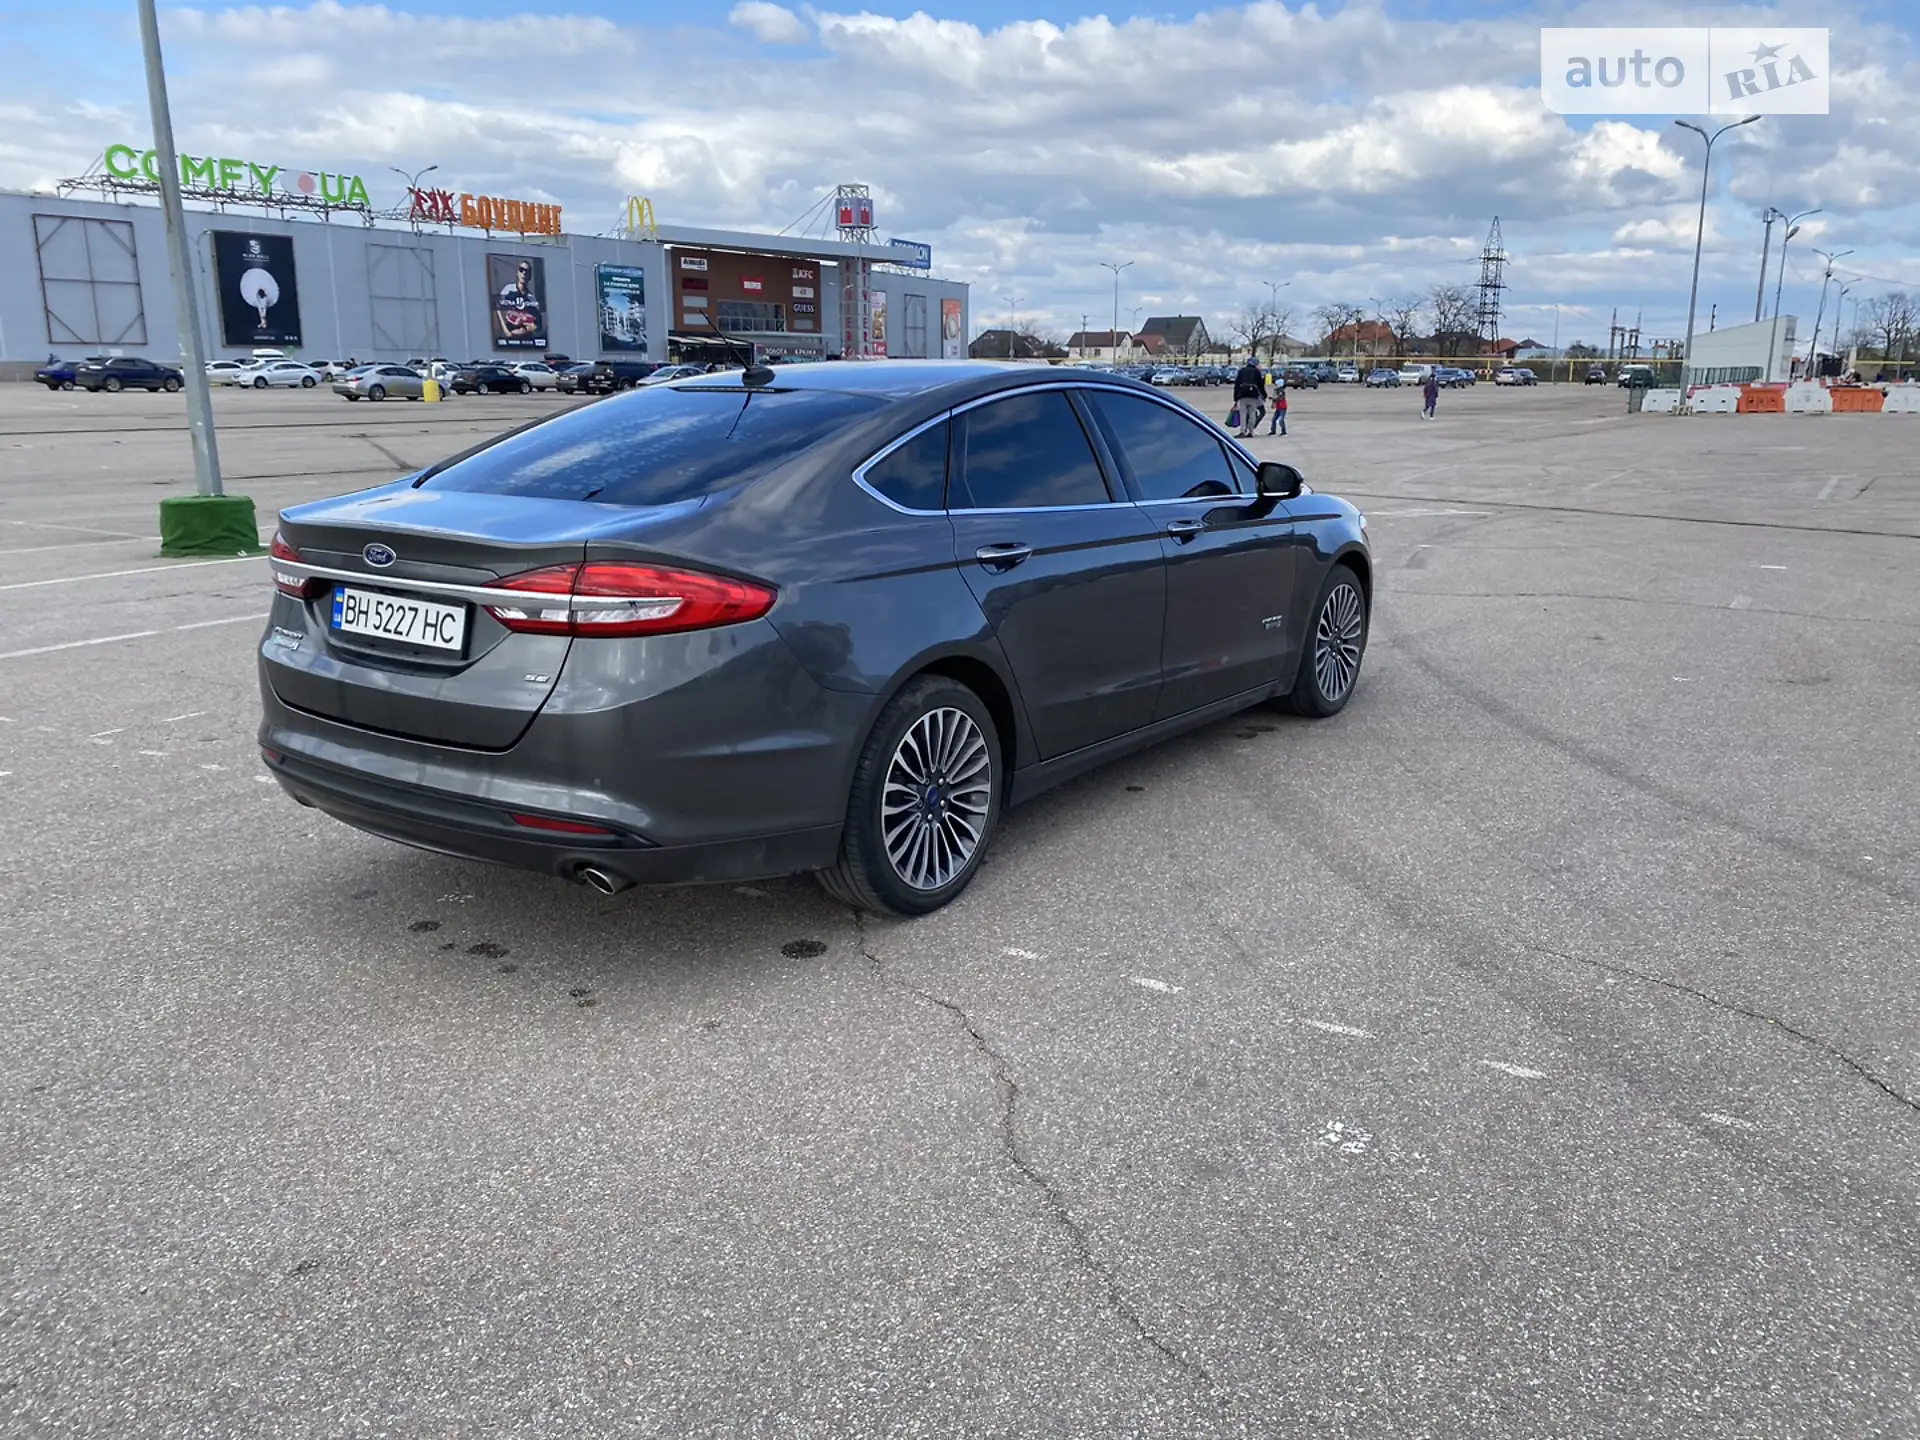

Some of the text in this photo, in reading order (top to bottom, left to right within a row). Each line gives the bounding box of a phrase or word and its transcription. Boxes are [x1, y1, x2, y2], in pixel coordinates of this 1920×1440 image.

[344, 594, 457, 644] BH 5227 HC
